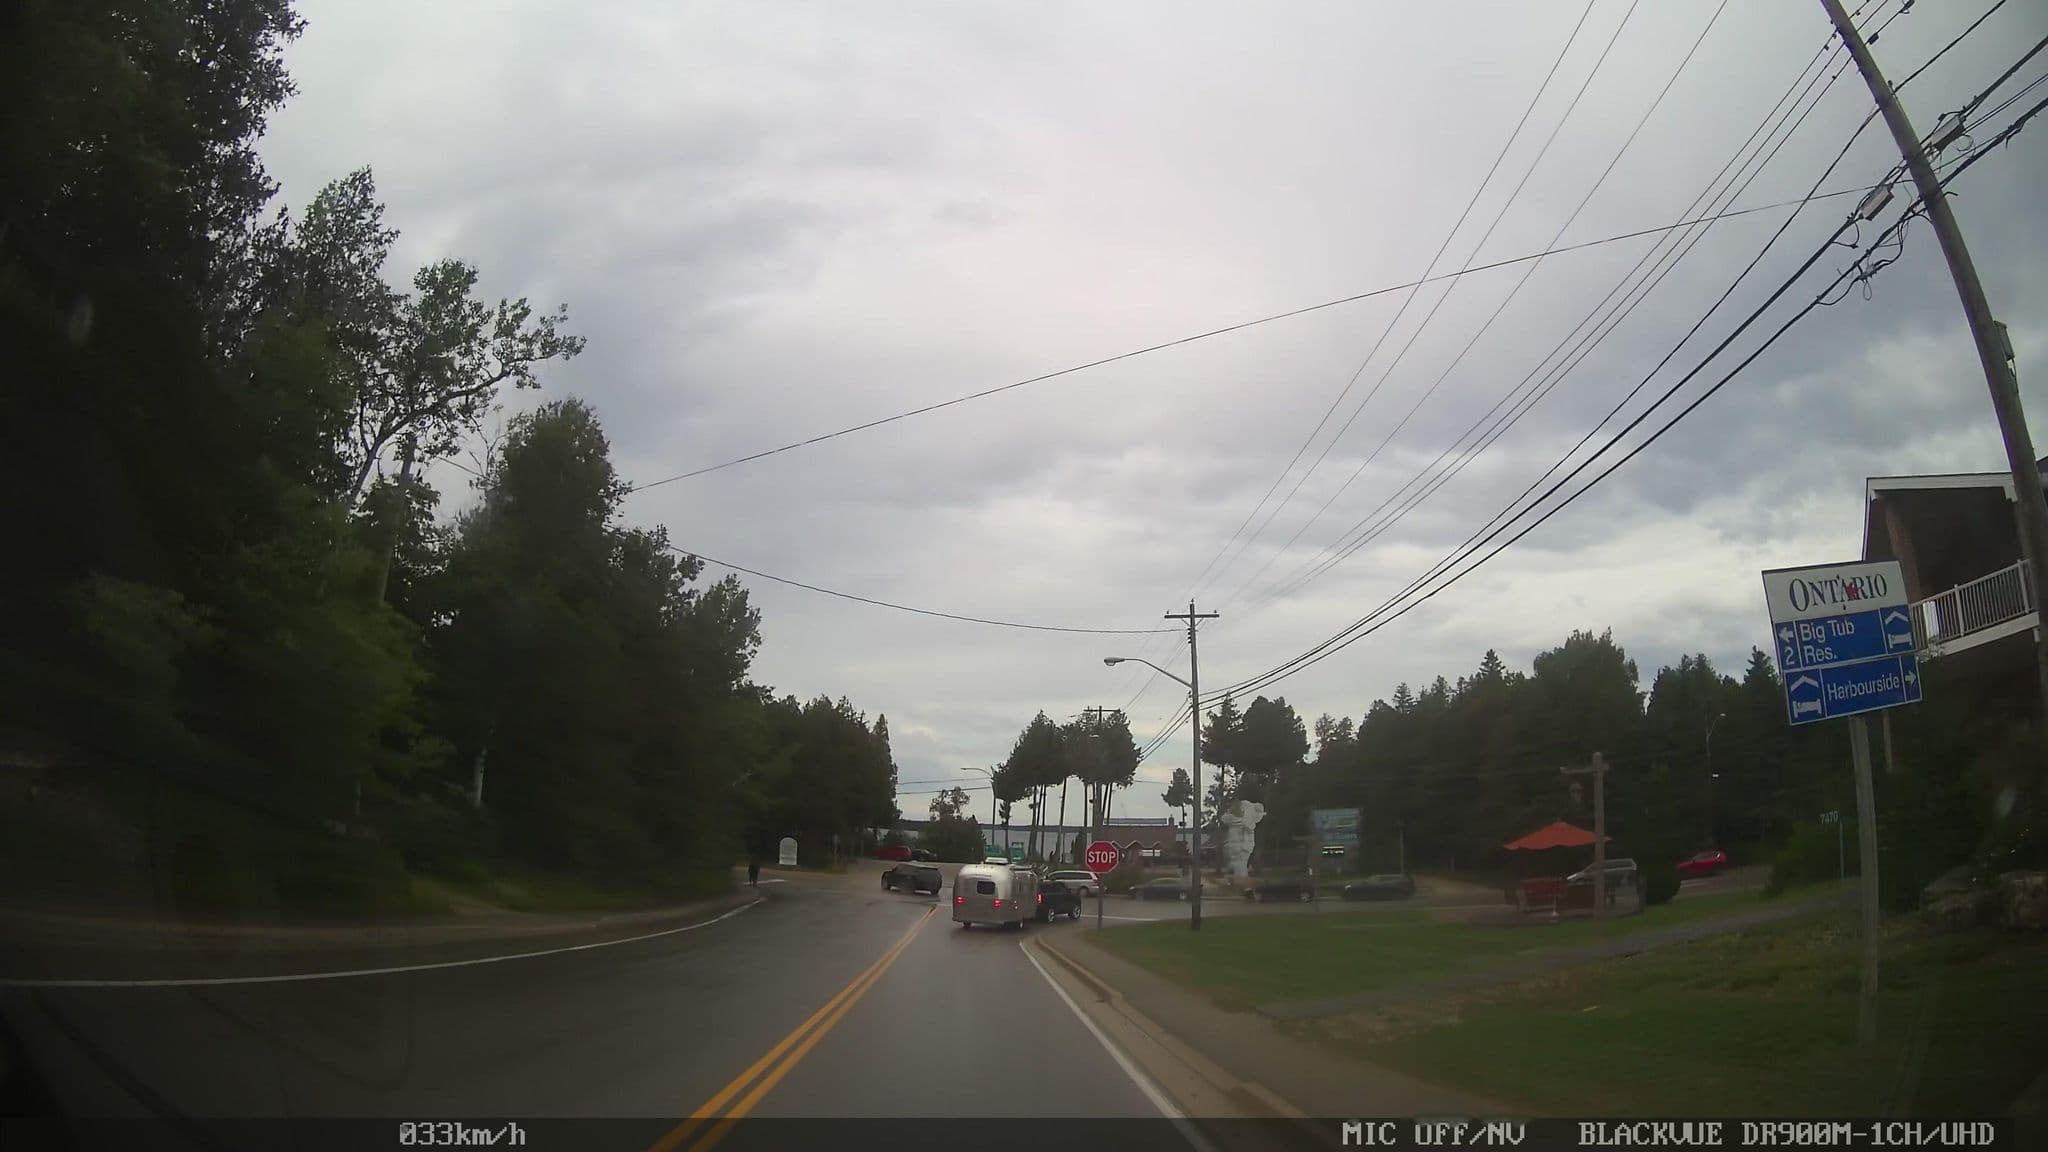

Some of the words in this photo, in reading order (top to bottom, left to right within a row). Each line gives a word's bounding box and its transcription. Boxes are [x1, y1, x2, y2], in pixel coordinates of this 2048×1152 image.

[1789, 573, 1888, 612] ONTARIO
[1800, 623, 1826, 643] Big
[1827, 619, 1855, 636] Tub
[1784, 647, 1795, 666] 2
[1803, 645, 1838, 665] Res.
[1827, 673, 1900, 701] Harbourside
[1088, 851, 1116, 863] STOP
